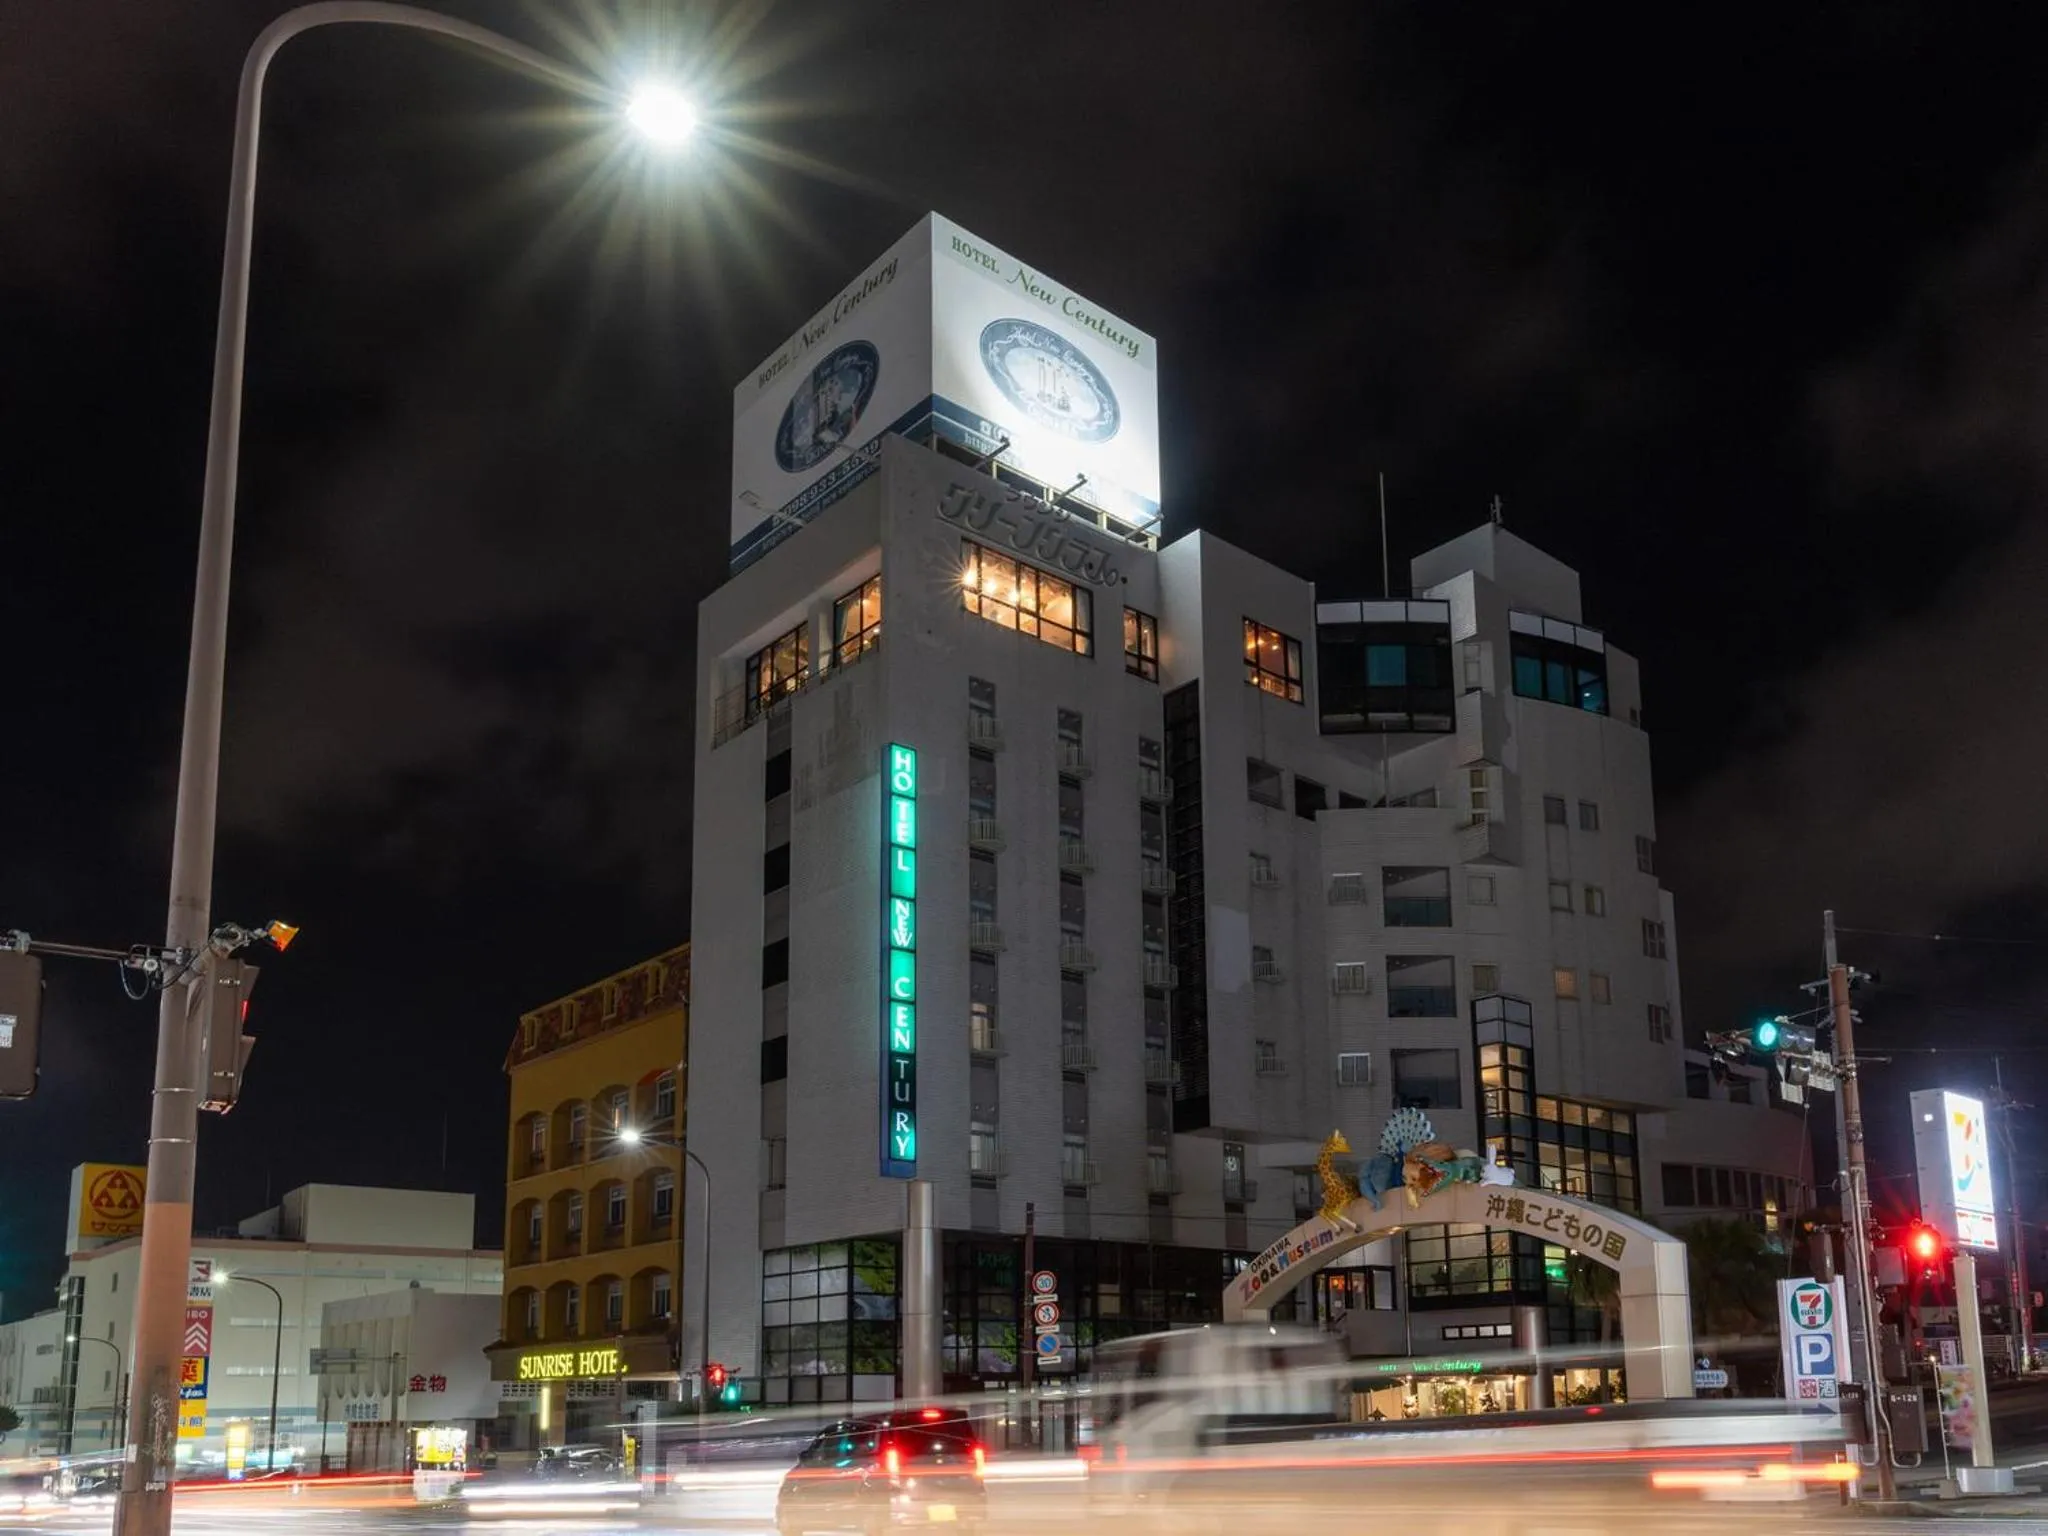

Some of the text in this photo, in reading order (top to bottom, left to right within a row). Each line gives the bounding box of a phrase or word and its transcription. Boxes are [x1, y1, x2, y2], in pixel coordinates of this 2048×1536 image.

[952, 236, 1141, 359] HOTEL New Century
[759, 354, 789, 389] HOTEL
[834, 258, 899, 324] Century
[894, 747, 912, 1156] HOTEL NEW CENTURY
[1486, 1194, 1627, 1262] 沖縄こどもの国
[1251, 1238, 1291, 1273] OKINAWA
[1039, 1277, 1052, 1289] 30
[520, 1352, 574, 1379] SUNRISE
[1800, 1336, 1831, 1374] P
[409, 1373, 447, 1393] 金物
